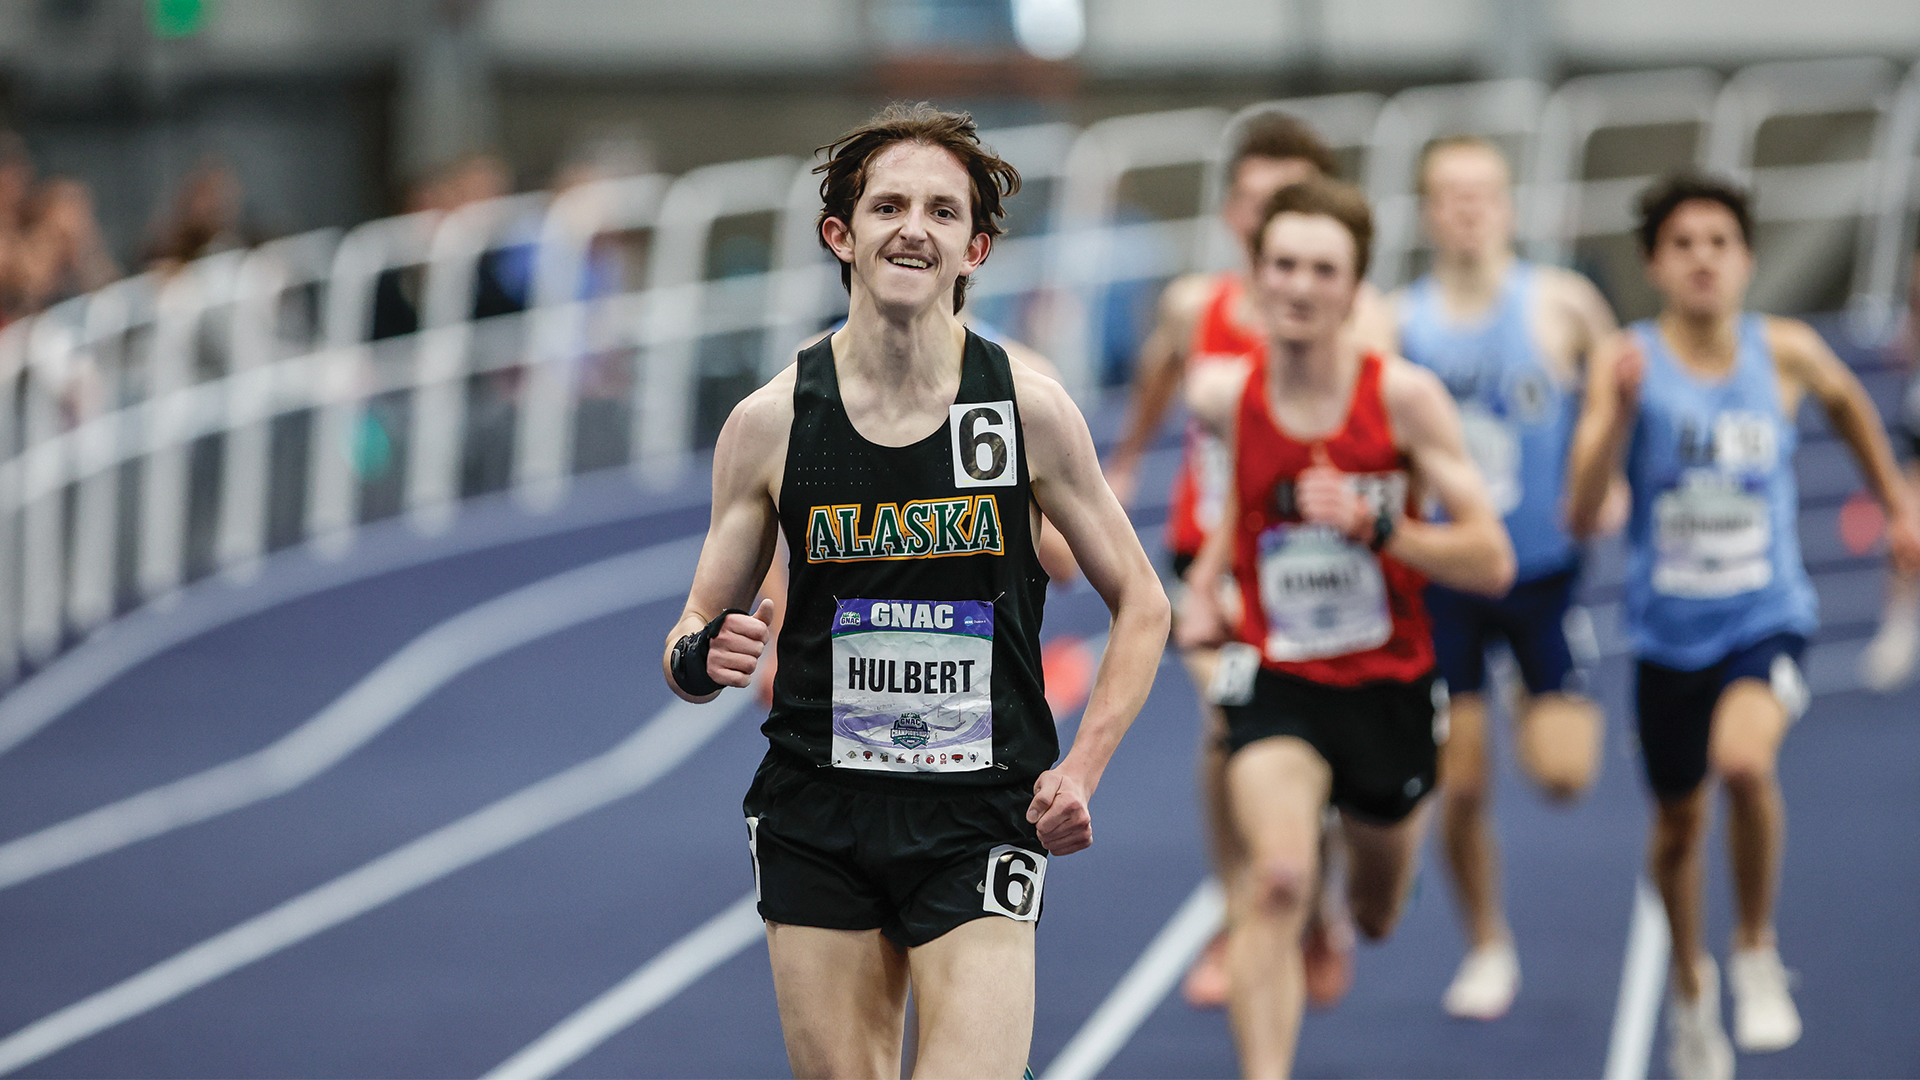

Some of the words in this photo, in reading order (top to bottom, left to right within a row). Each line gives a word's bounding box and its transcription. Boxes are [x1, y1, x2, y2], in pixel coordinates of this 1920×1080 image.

[959, 407, 1008, 480] 6
[806, 495, 1004, 563] ALASKA
[841, 617, 860, 625] GNAC
[870, 602, 954, 630] GNAC
[848, 656, 975, 694] HULBERT
[900, 718, 921, 727] GNAC
[993, 850, 1038, 916] 6
